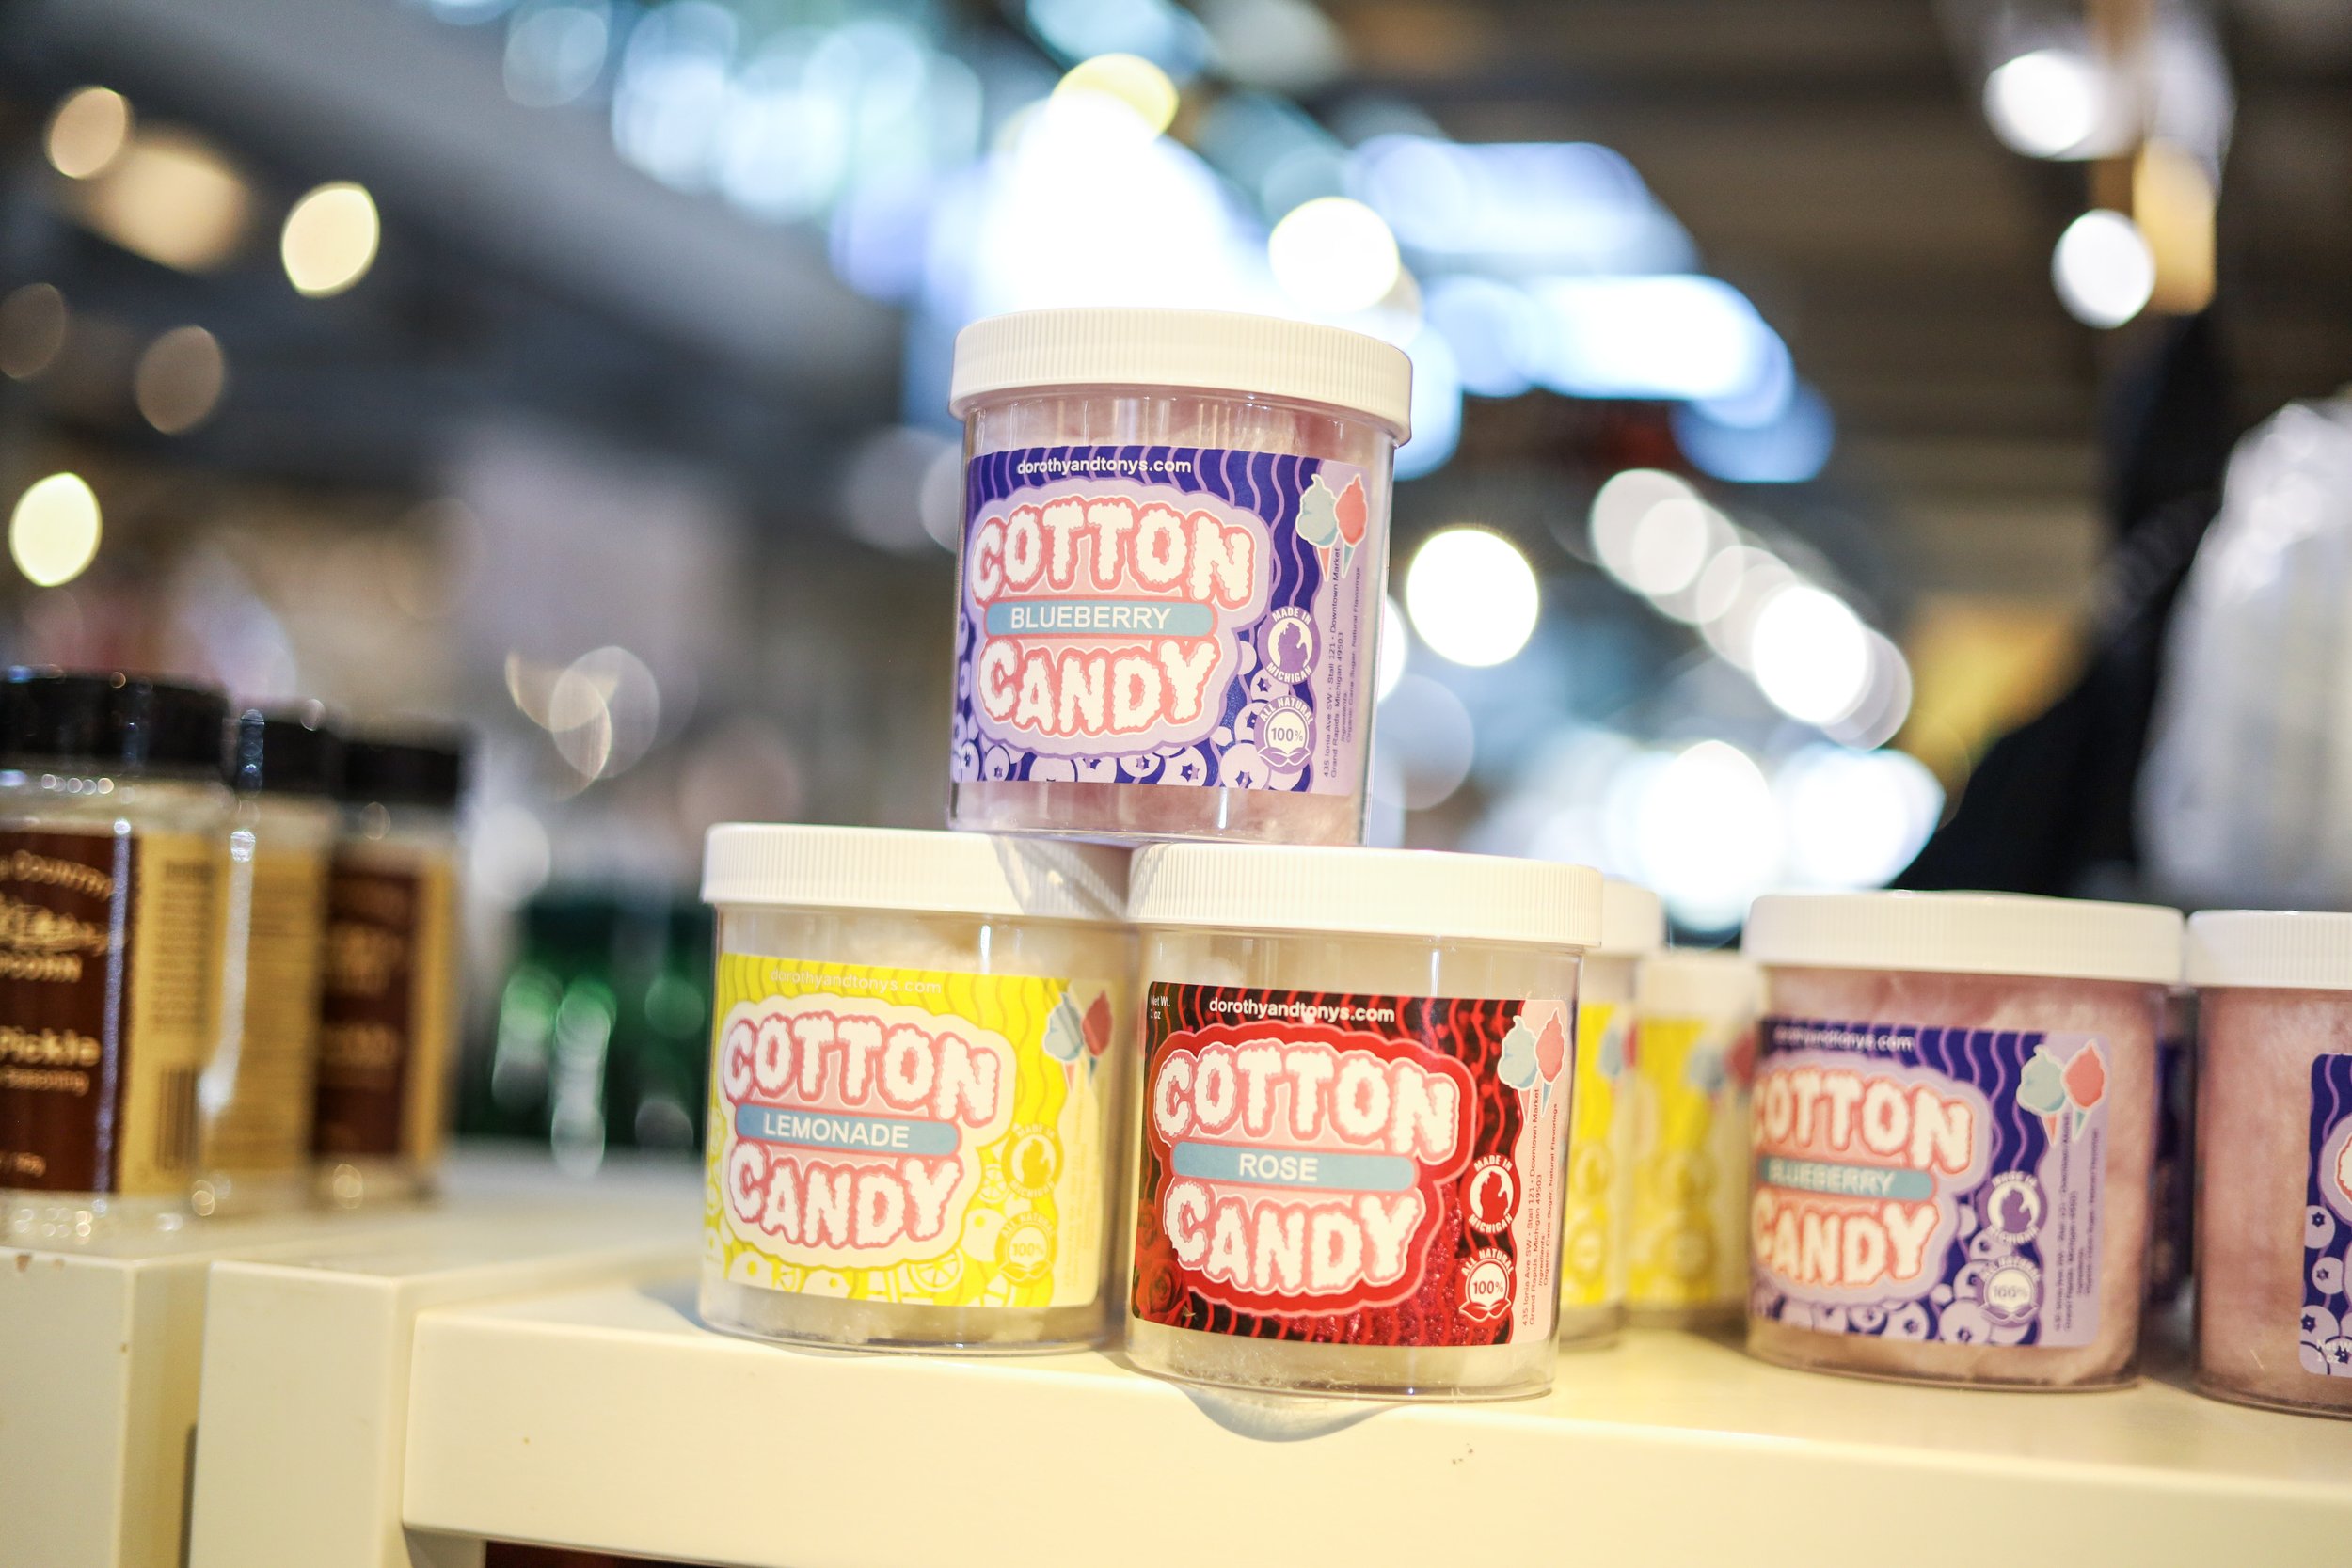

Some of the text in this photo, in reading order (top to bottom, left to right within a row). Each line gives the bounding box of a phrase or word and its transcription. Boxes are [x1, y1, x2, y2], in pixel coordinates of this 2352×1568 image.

[1017, 456, 1191, 475] dorothyandtonys.com
[972, 499, 1252, 602] COTTON
[1010, 606, 1172, 629] BLUEBERRY
[1271, 607, 1312, 626] MADE IN
[1329, 584, 1339, 633] Downtown
[1266, 661, 1312, 684] MICHIGAN
[1334, 665, 1343, 708] Michigan
[979, 640, 1216, 734] CANDY
[1260, 696, 1314, 725] ALL NATURAL
[1327, 692, 1333, 711] SW
[1270, 726, 1304, 742] 100%
[770, 969, 942, 994] dorothyandtonys.com
[1151, 995, 1160, 1006] Net
[1209, 997, 1395, 1022] dorothyandtonys.com
[723, 1015, 998, 1121] COTTON
[1154, 1045, 1454, 1153] COTTON
[763, 1112, 910, 1148] LEMONADE
[1239, 1153, 1319, 1182] ROSE
[1474, 1154, 1513, 1172] MADE IN
[729, 1143, 961, 1246] CANDY
[1525, 1239, 1532, 1257] SW
[1529, 1126, 1537, 1177] Downtown
[1167, 1181, 1419, 1290] CANDY
[1469, 1213, 1513, 1234] MICHIGAN
[1752, 1189, 1940, 1285] CANDY
[1461, 1248, 1514, 1276] ALL NATURAL
[1472, 1280, 1503, 1295] 100%
